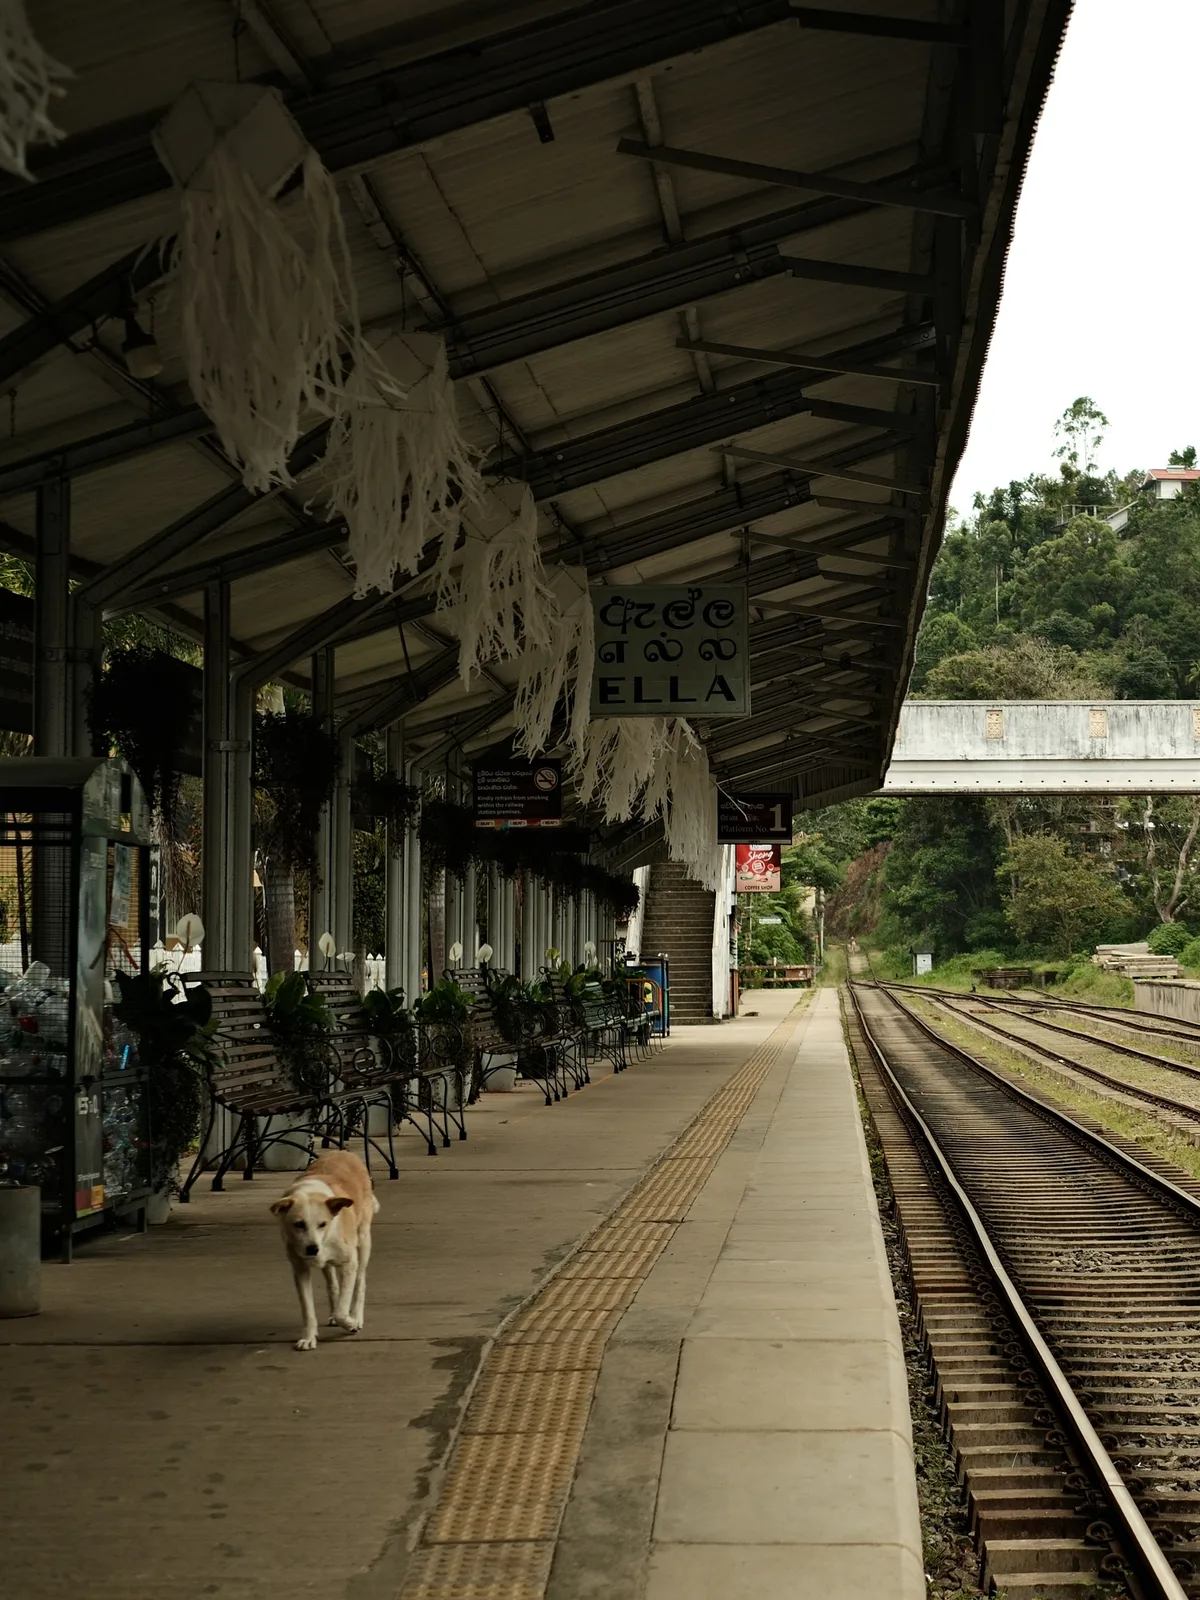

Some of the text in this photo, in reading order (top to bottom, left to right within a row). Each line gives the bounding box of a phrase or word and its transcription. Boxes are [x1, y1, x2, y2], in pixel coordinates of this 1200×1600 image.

[599, 588, 735, 634] ඇල්ල
[598, 632, 737, 664] எல்ல
[598, 675, 736, 704] ELLA
[769, 804, 787, 831] 1
